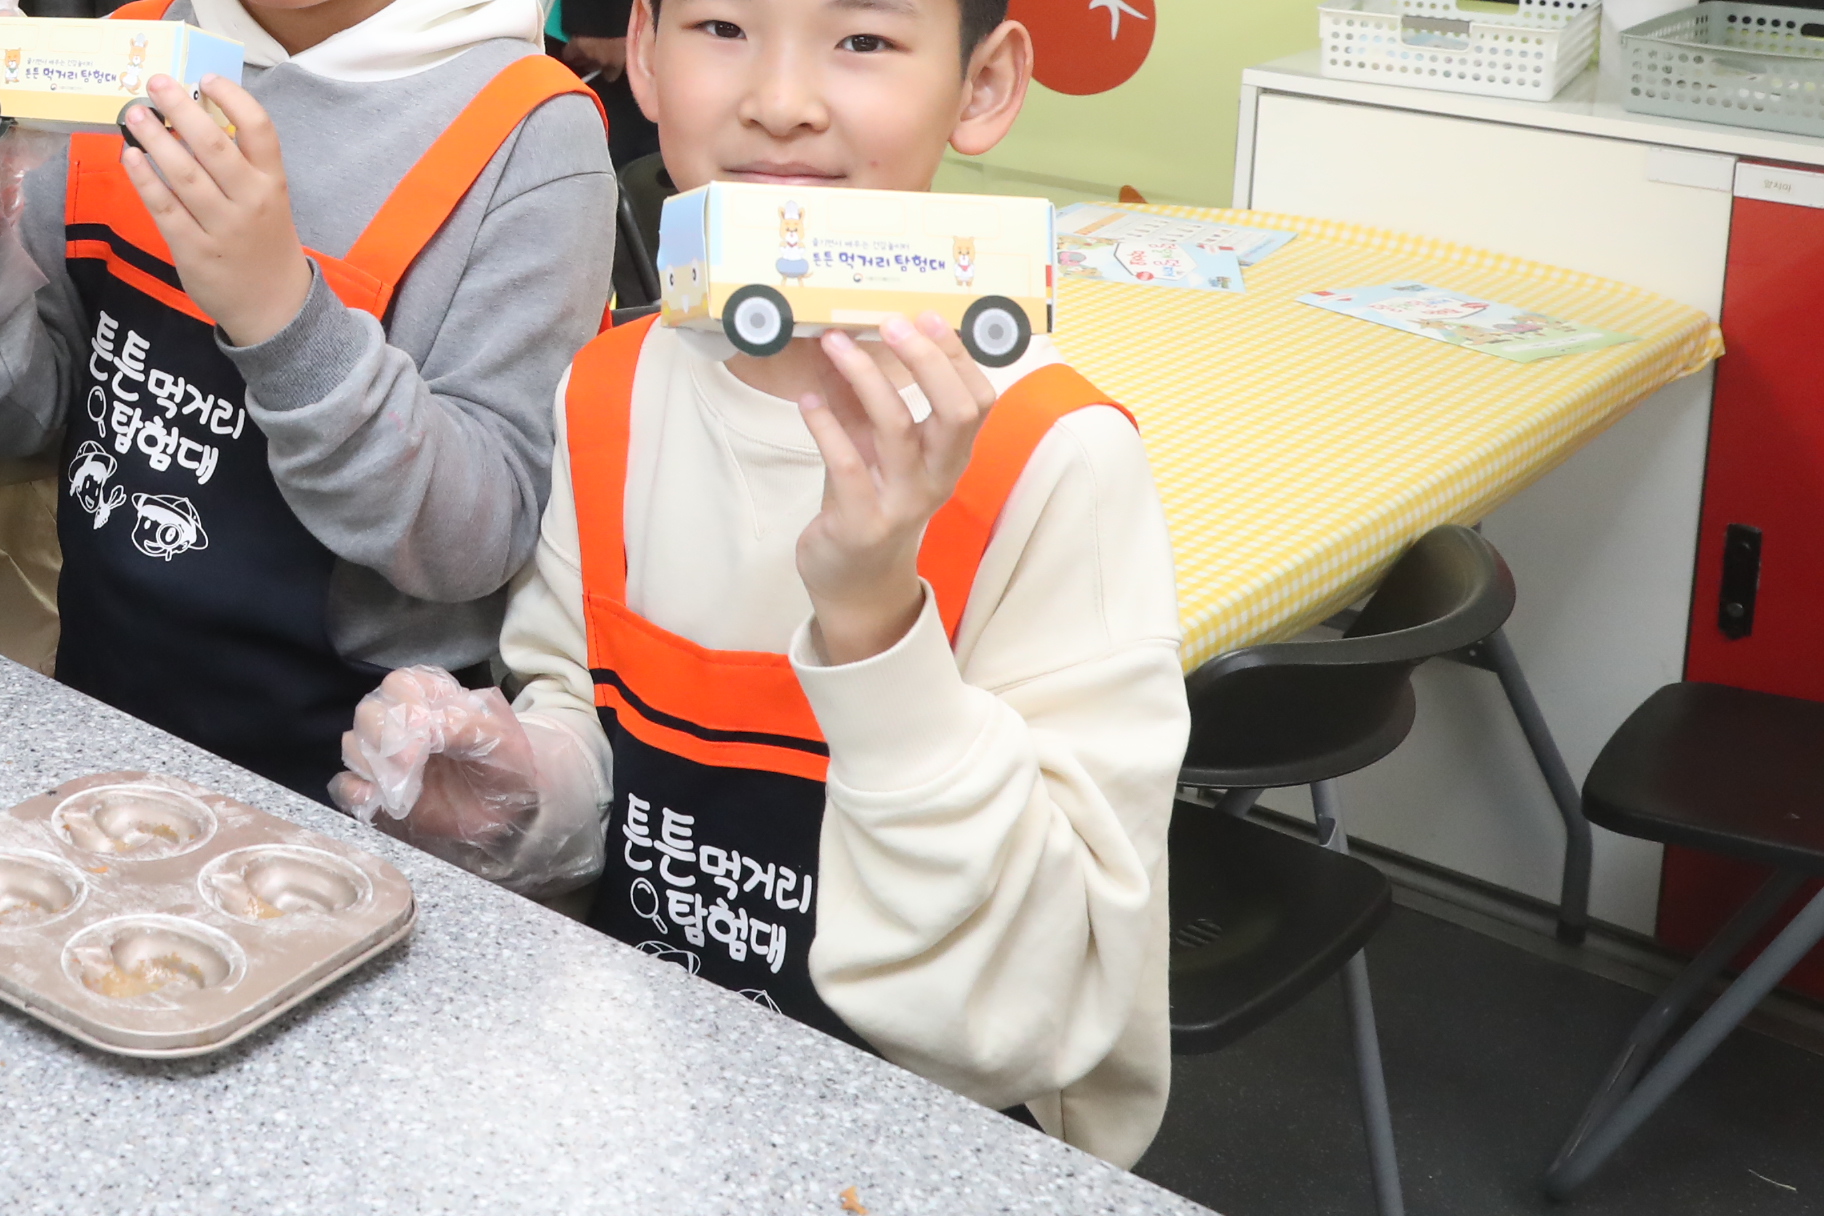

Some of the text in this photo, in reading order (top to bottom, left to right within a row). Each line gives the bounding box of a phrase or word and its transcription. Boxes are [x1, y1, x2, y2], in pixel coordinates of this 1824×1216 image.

[43, 67, 78, 81] 먹거리
[813, 251, 834, 268] 튼튼
[838, 252, 891, 270] 먹거리
[89, 310, 245, 439] 튼튼 먹거리
[111, 401, 219, 485] 탐험대
[622, 792, 812, 914] 튼튼 먹거리
[666, 889, 787, 974] 탐험대
